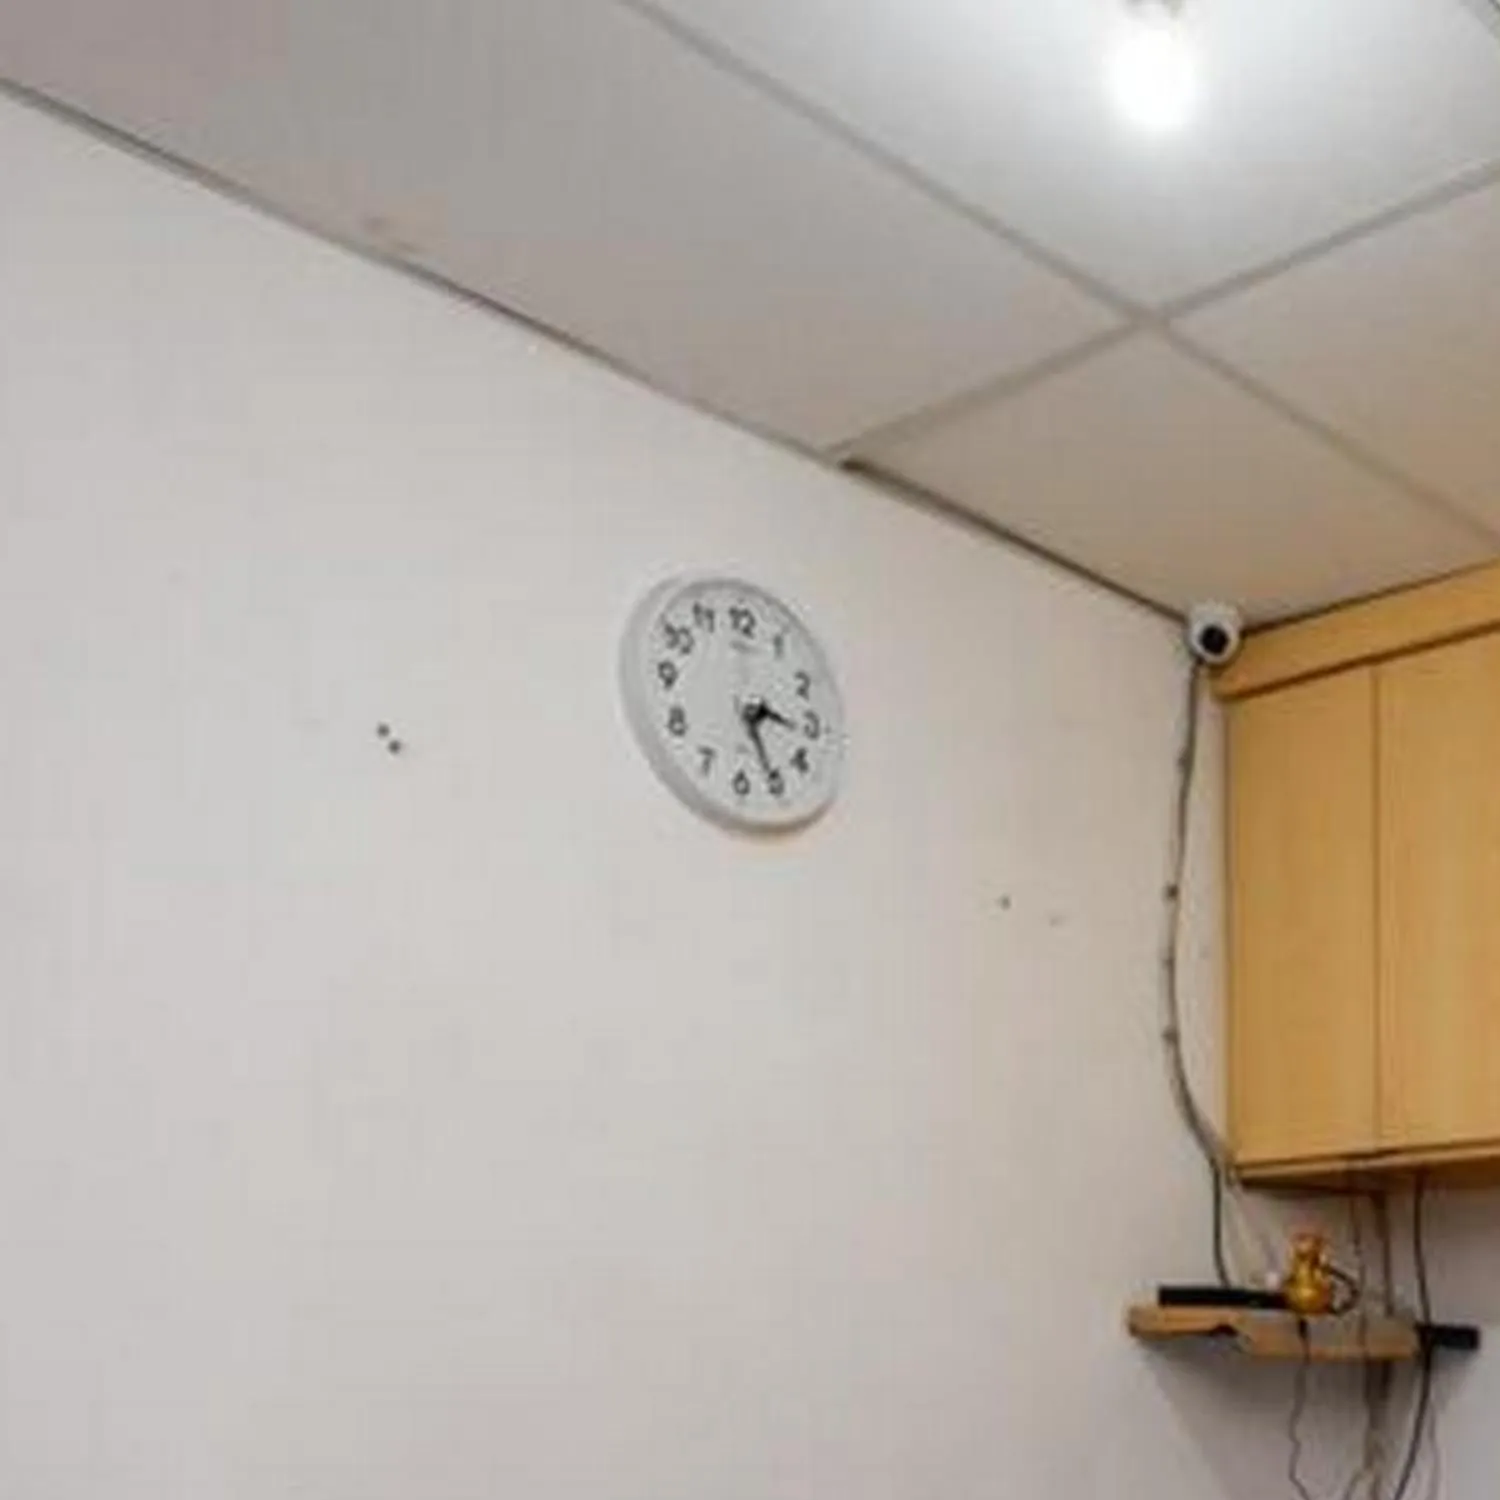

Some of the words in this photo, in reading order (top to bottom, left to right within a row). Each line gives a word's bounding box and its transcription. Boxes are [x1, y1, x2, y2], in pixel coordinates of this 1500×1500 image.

[728, 606, 757, 639] 12
[657, 660, 679, 690] 9
[795, 671, 811, 700] 2
[803, 710, 821, 741] 3
